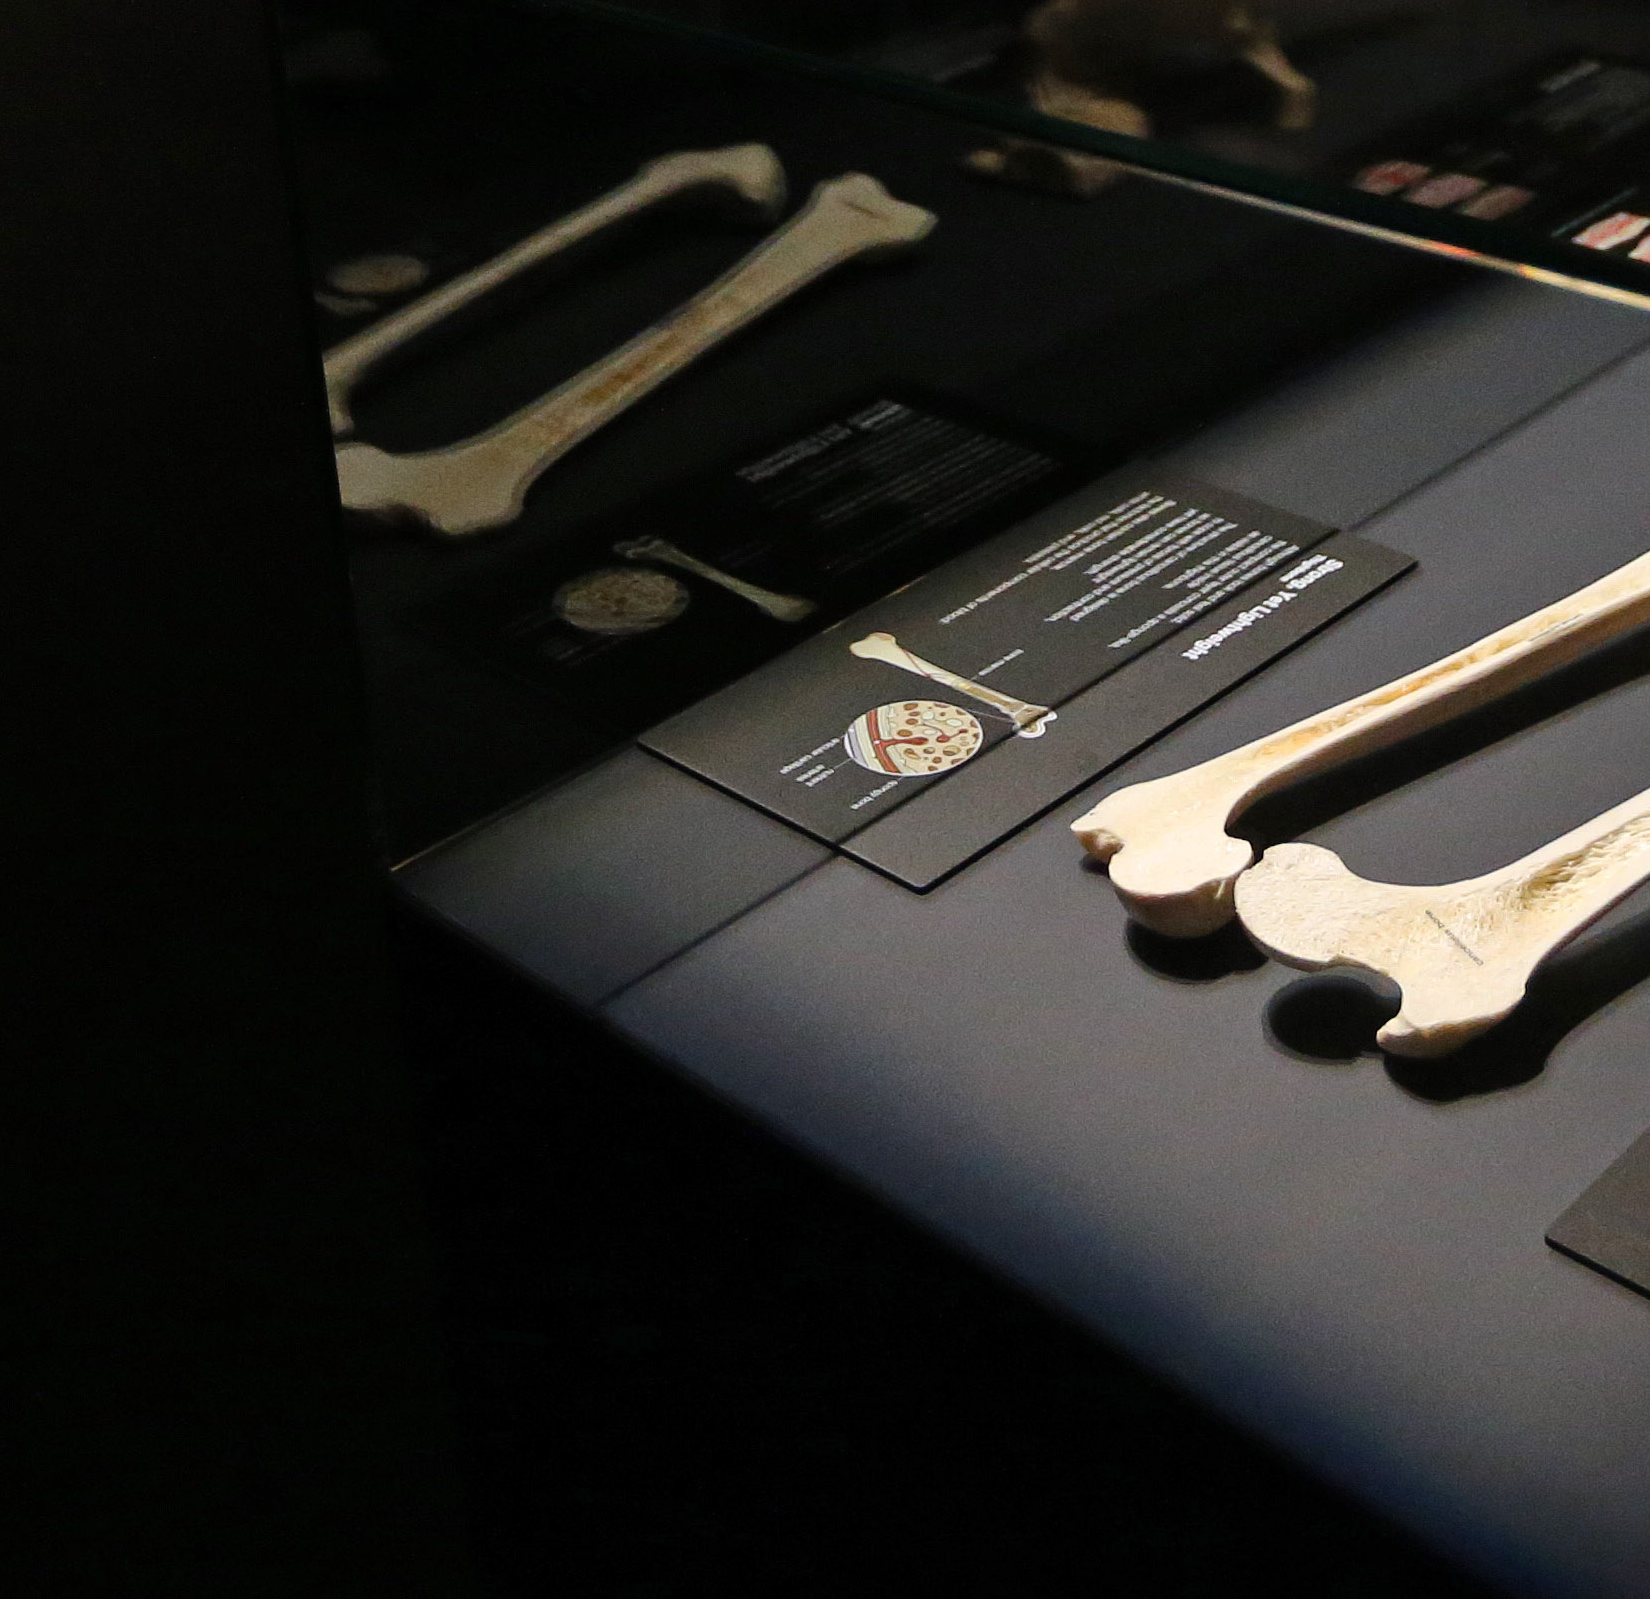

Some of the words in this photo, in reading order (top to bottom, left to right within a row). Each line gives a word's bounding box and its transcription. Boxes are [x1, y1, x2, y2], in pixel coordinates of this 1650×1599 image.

[1285, 557, 1343, 589] Strong,
[1261, 590, 1297, 608] Yet
[1181, 604, 1272, 660] Lightweight
